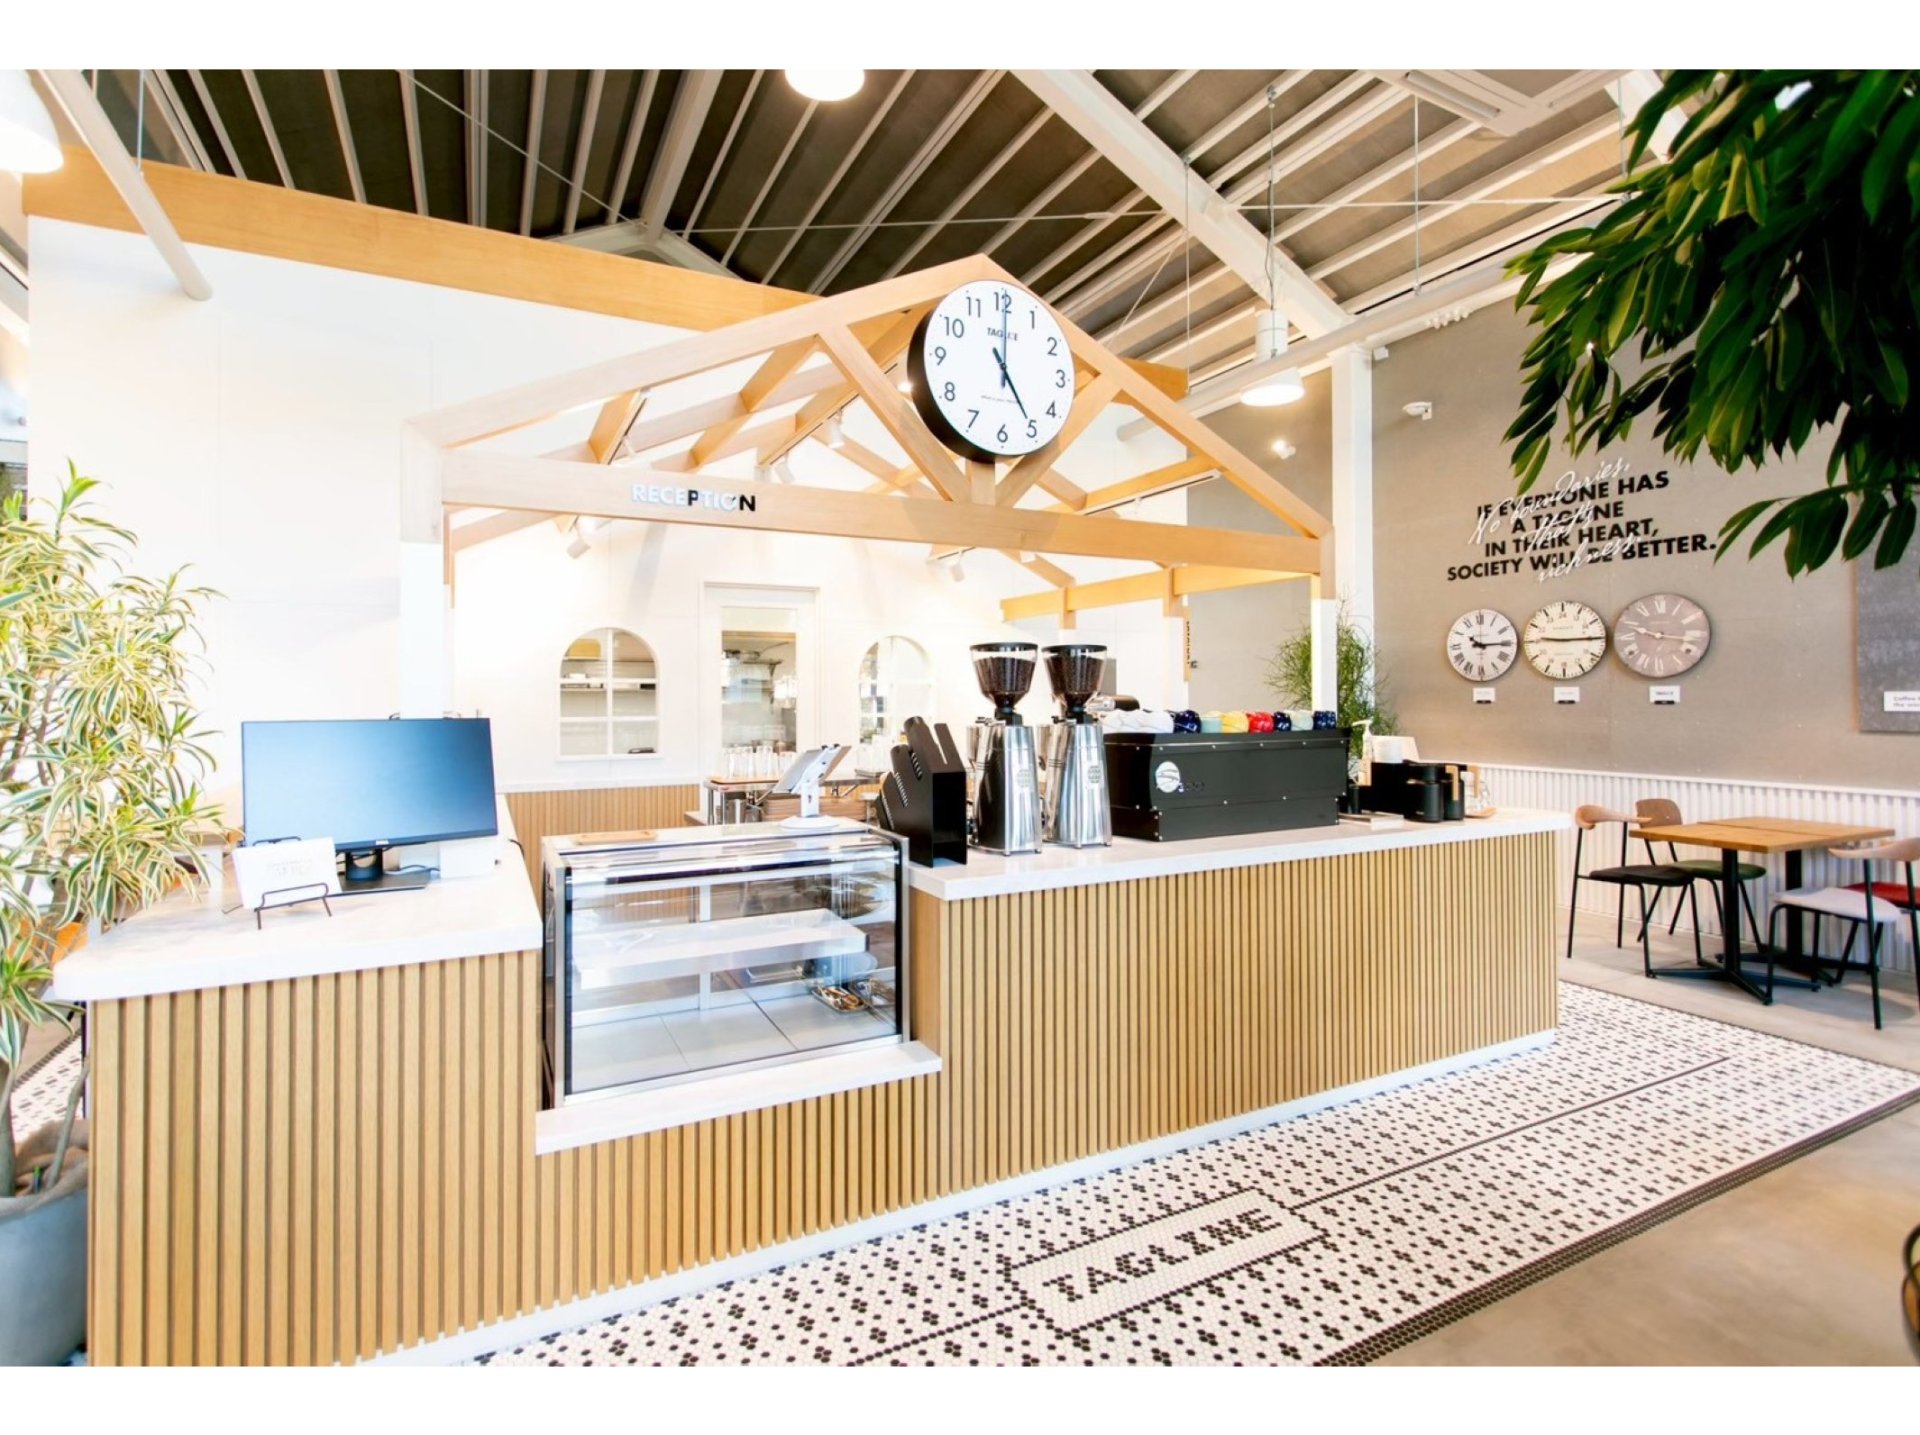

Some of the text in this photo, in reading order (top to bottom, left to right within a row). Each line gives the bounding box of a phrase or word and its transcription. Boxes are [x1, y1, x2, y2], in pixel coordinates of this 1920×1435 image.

[966, 296, 981, 318] 11
[994, 292, 1012, 313] 12
[944, 316, 965, 338] 10
[1029, 310, 1035, 330] 1
[934, 346, 947, 366] 9
[1047, 337, 1058, 356] 2
[1056, 369, 1066, 388] 3
[944, 381, 956, 402] 8
[967, 409, 980, 429] 7
[1046, 401, 1057, 418] 4
[997, 424, 1009, 443] 6
[1026, 419, 1038, 439] 5
[631, 483, 757, 512] RECEPTION
[1477, 504, 1493, 519] IF
[1618, 471, 1669, 495] HAS
[1511, 517, 1526, 534] A
[1485, 518, 1659, 557] IN THEIR HEART,
[1447, 558, 1524, 581] SOCIETY
[1530, 551, 1580, 571] WILL
[1622, 534, 1717, 560] BETTER.
[1043, 1208, 1282, 1302] TAGLINE
